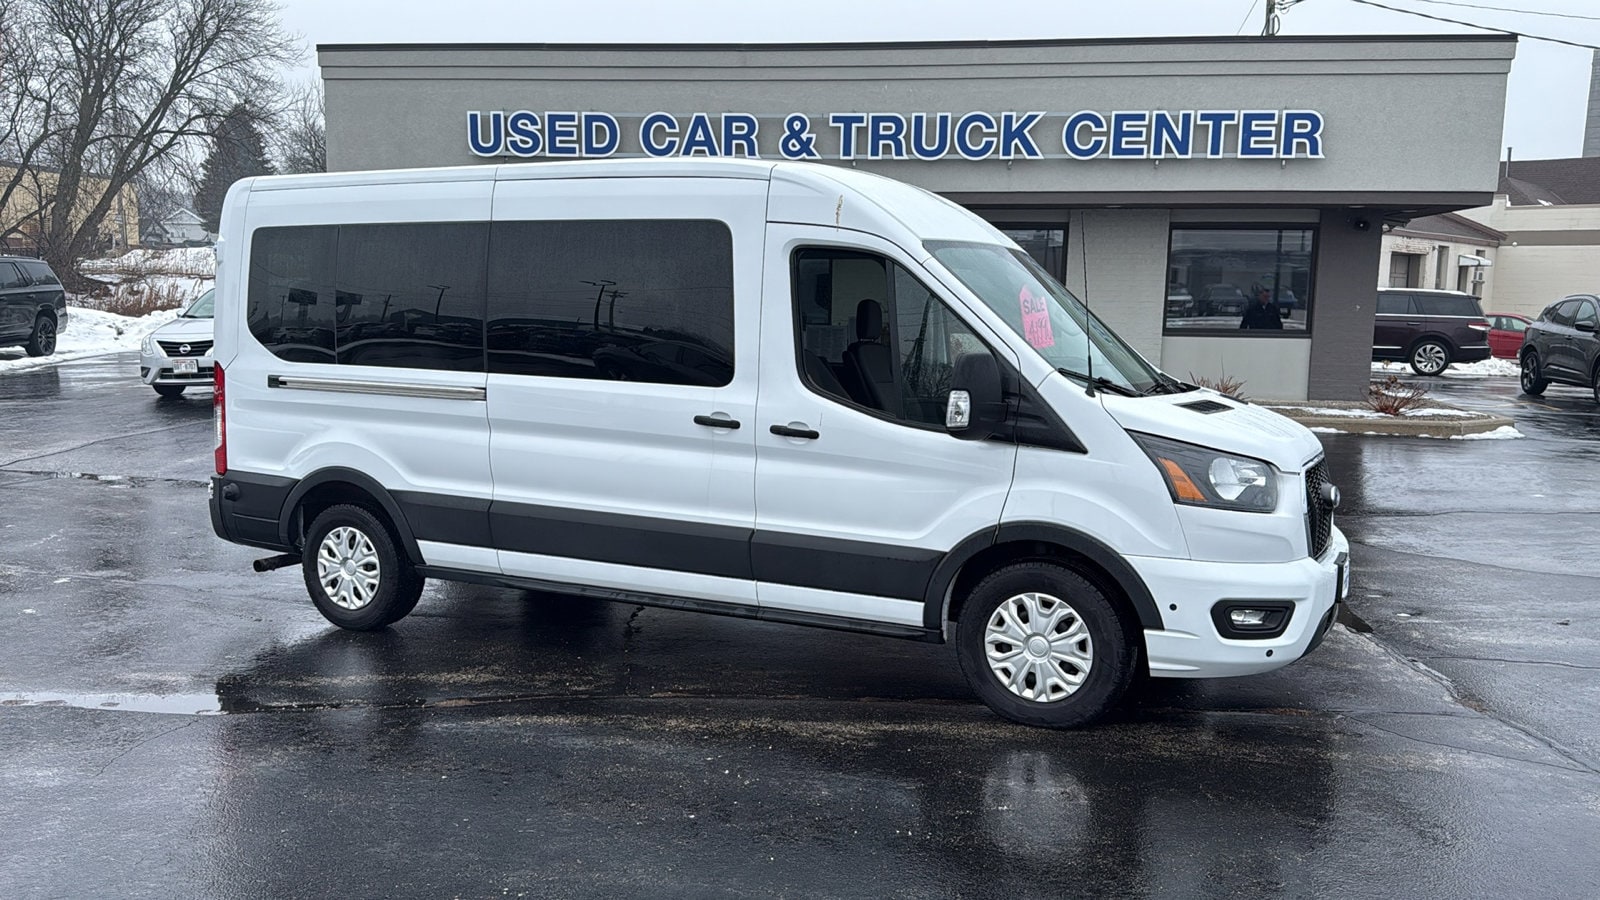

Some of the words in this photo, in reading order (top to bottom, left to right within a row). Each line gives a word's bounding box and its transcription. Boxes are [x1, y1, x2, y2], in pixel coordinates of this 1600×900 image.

[467, 110, 620, 158] USED
[639, 110, 761, 159] CAR
[779, 112, 822, 160] &
[829, 110, 1046, 161] TRUCK
[1061, 109, 1326, 161] CENTER
[1022, 298, 1045, 314] SALE
